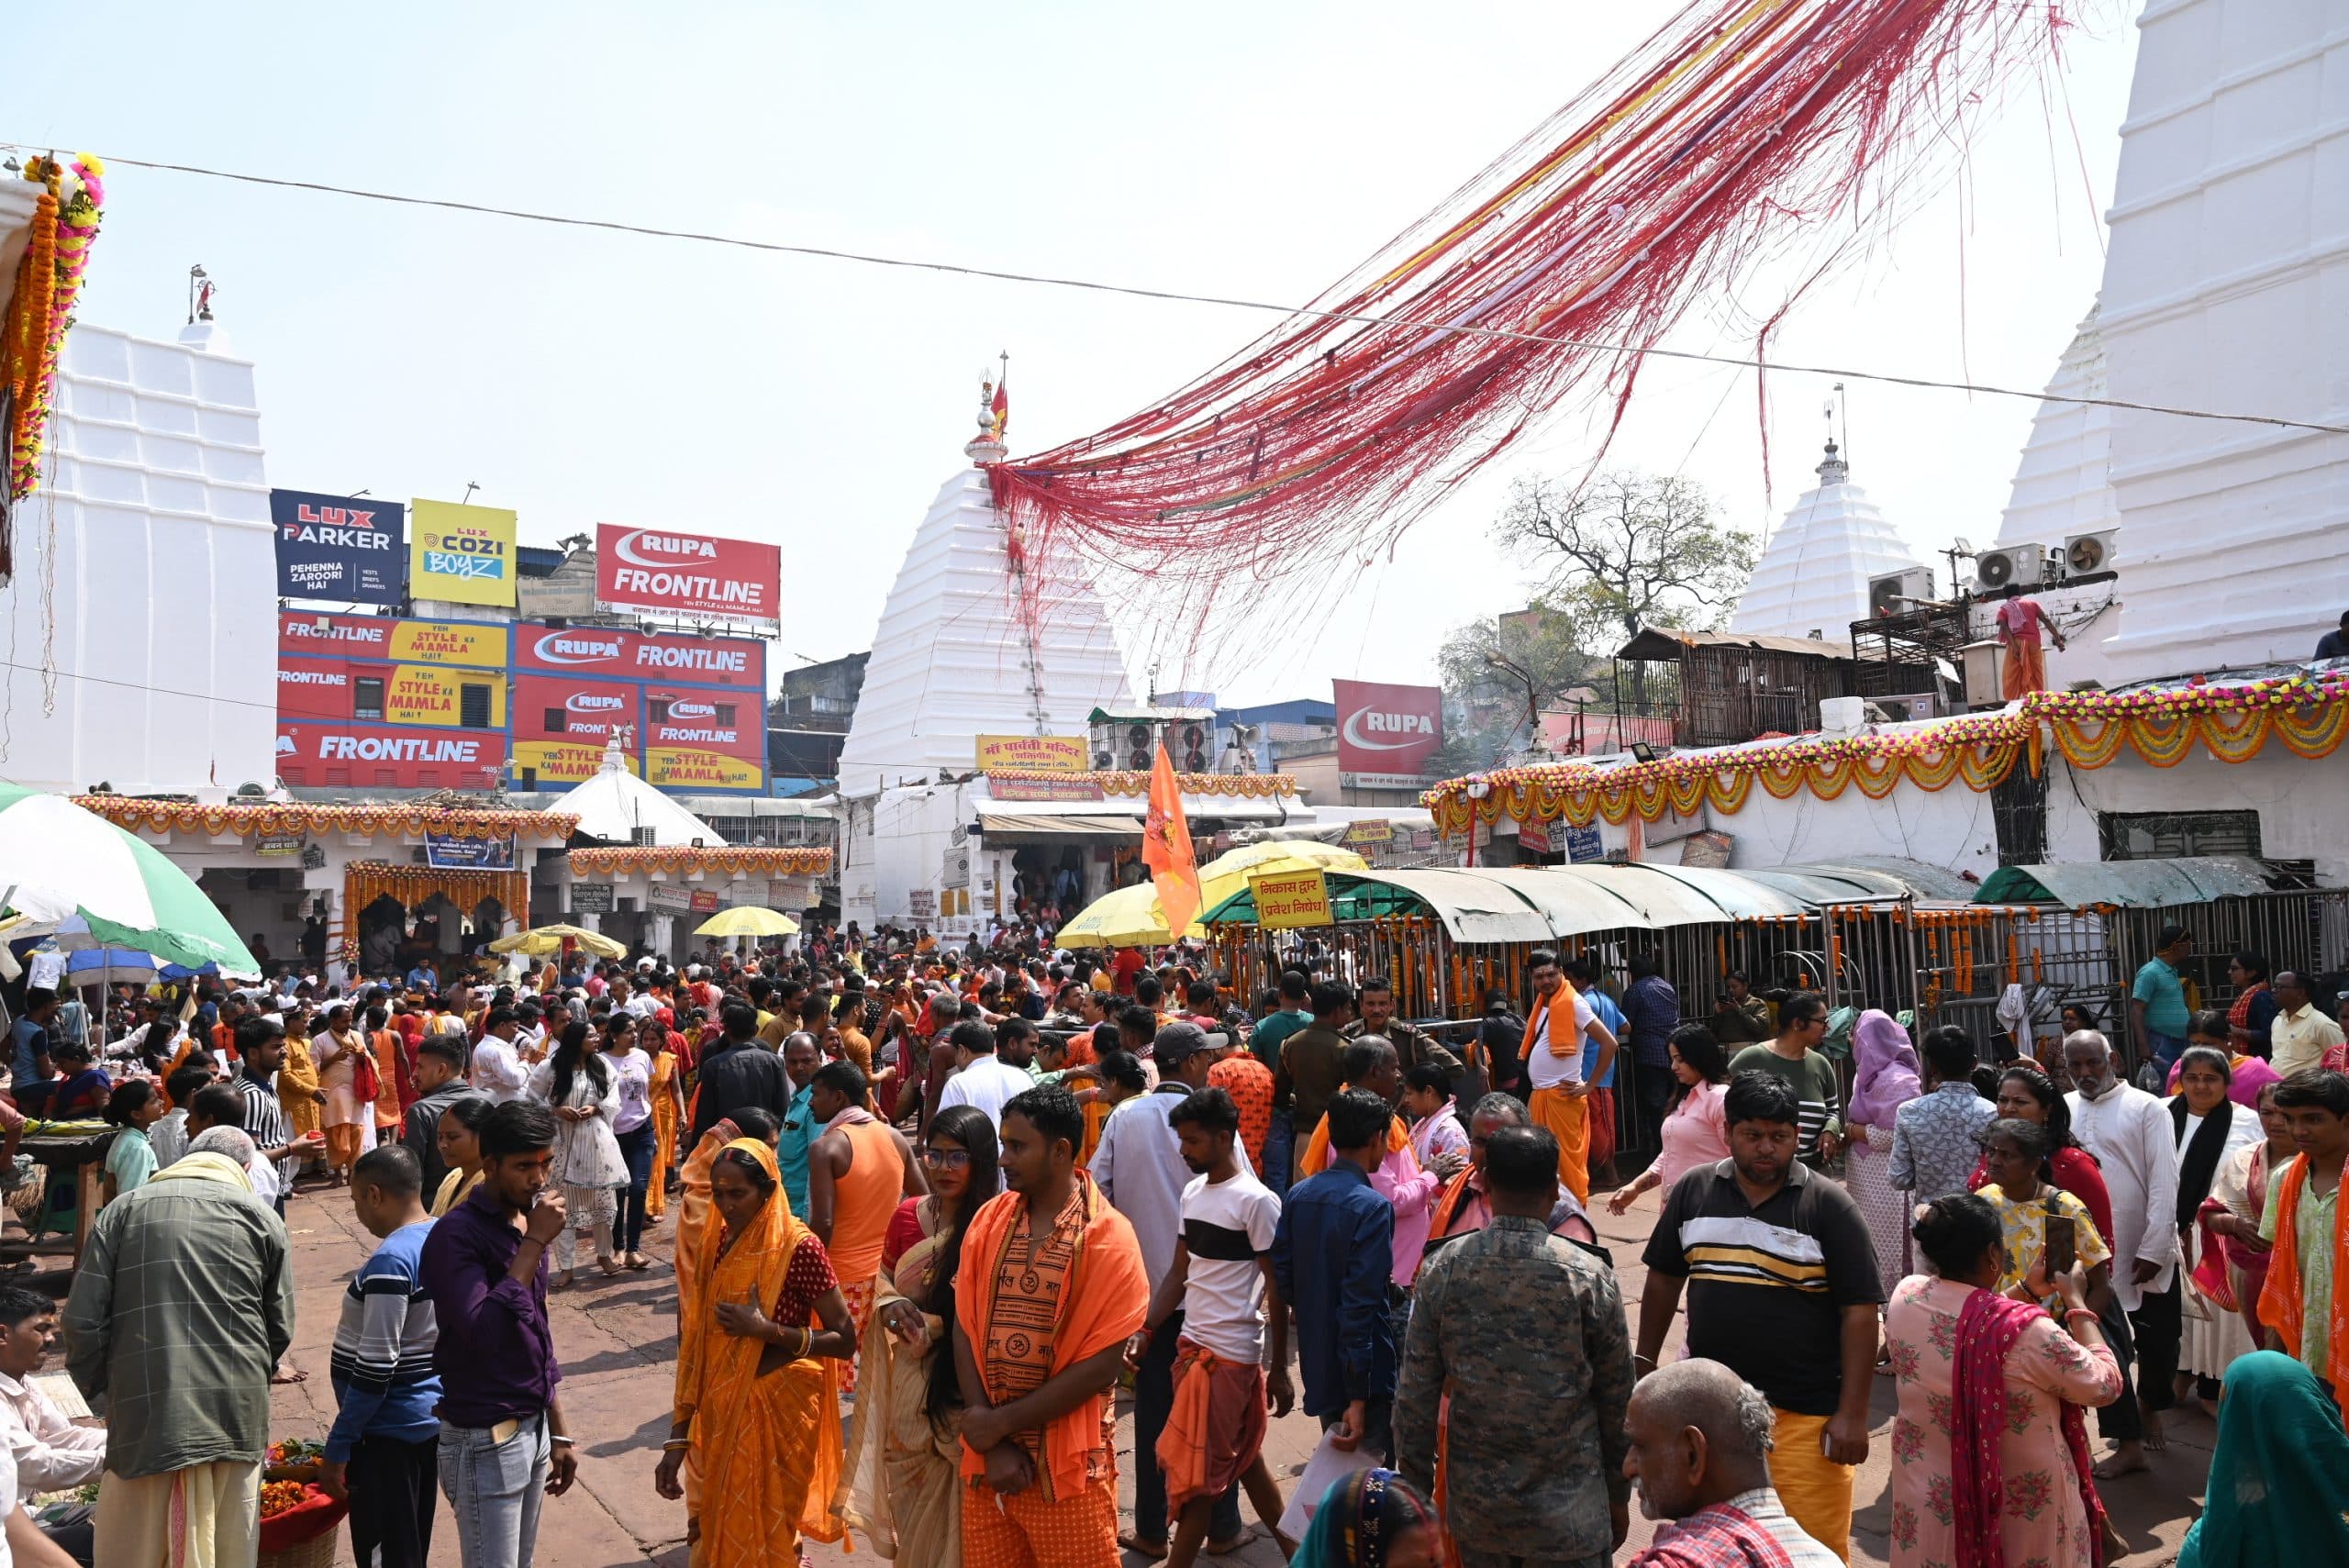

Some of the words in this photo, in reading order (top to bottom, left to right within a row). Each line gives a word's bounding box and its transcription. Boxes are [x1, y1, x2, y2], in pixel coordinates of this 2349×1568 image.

[298, 504, 375, 528] LUX
[284, 523, 390, 550] PARKER
[457, 528, 488, 537] LUX
[442, 536, 503, 555] COZI
[642, 534, 718, 558] RUPA
[290, 562, 343, 573] PEHENNA
[292, 571, 341, 582] ZAROORI
[307, 582, 327, 590] HAI
[615, 568, 763, 604] FRONTLINE
[286, 622, 384, 642] FRONTLINE
[417, 632, 458, 642] STYLE
[411, 642, 468, 653] MAMLA
[554, 639, 619, 657] RUPA
[637, 645, 747, 672] FRONTLINE
[399, 681, 440, 695] STYLE
[389, 695, 451, 710] MAMLA
[578, 695, 624, 708] RUPA
[679, 704, 716, 716] RUPA
[1367, 712, 1433, 734] RUPA
[659, 728, 737, 741] FRONTLINE
[318, 736, 479, 762] FRONTLINE
[1004, 740, 1041, 751] पार्वती
[558, 749, 603, 762] STYLE
[661, 757, 675, 765] YEH
[675, 753, 718, 766] STYLE
[551, 762, 598, 775] MAML
[670, 767, 723, 780] MAMLA
[1260, 881, 1297, 895] निकास
[1297, 880, 1318, 894] द्वार
